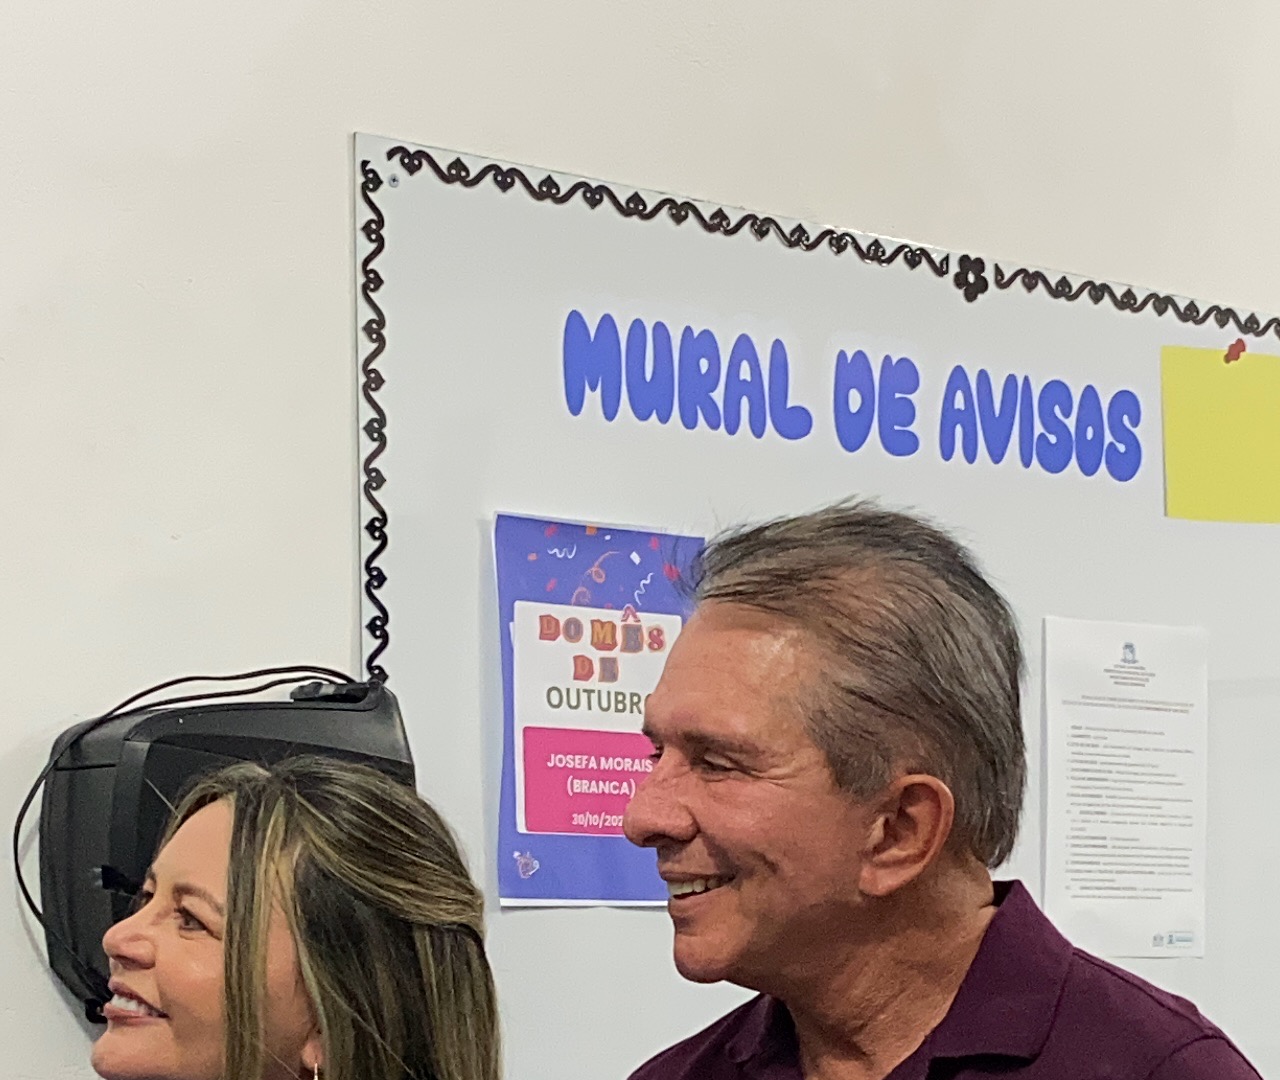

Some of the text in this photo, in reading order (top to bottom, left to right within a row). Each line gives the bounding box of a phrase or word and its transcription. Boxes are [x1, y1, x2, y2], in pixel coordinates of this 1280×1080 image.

[563, 310, 1142, 482] MURAL DE AVISOS
[547, 753, 654, 772] JOSEFA MORAIS
[567, 775, 636, 799] (BRANCA)
[572, 811, 624, 829] 30/10/202
